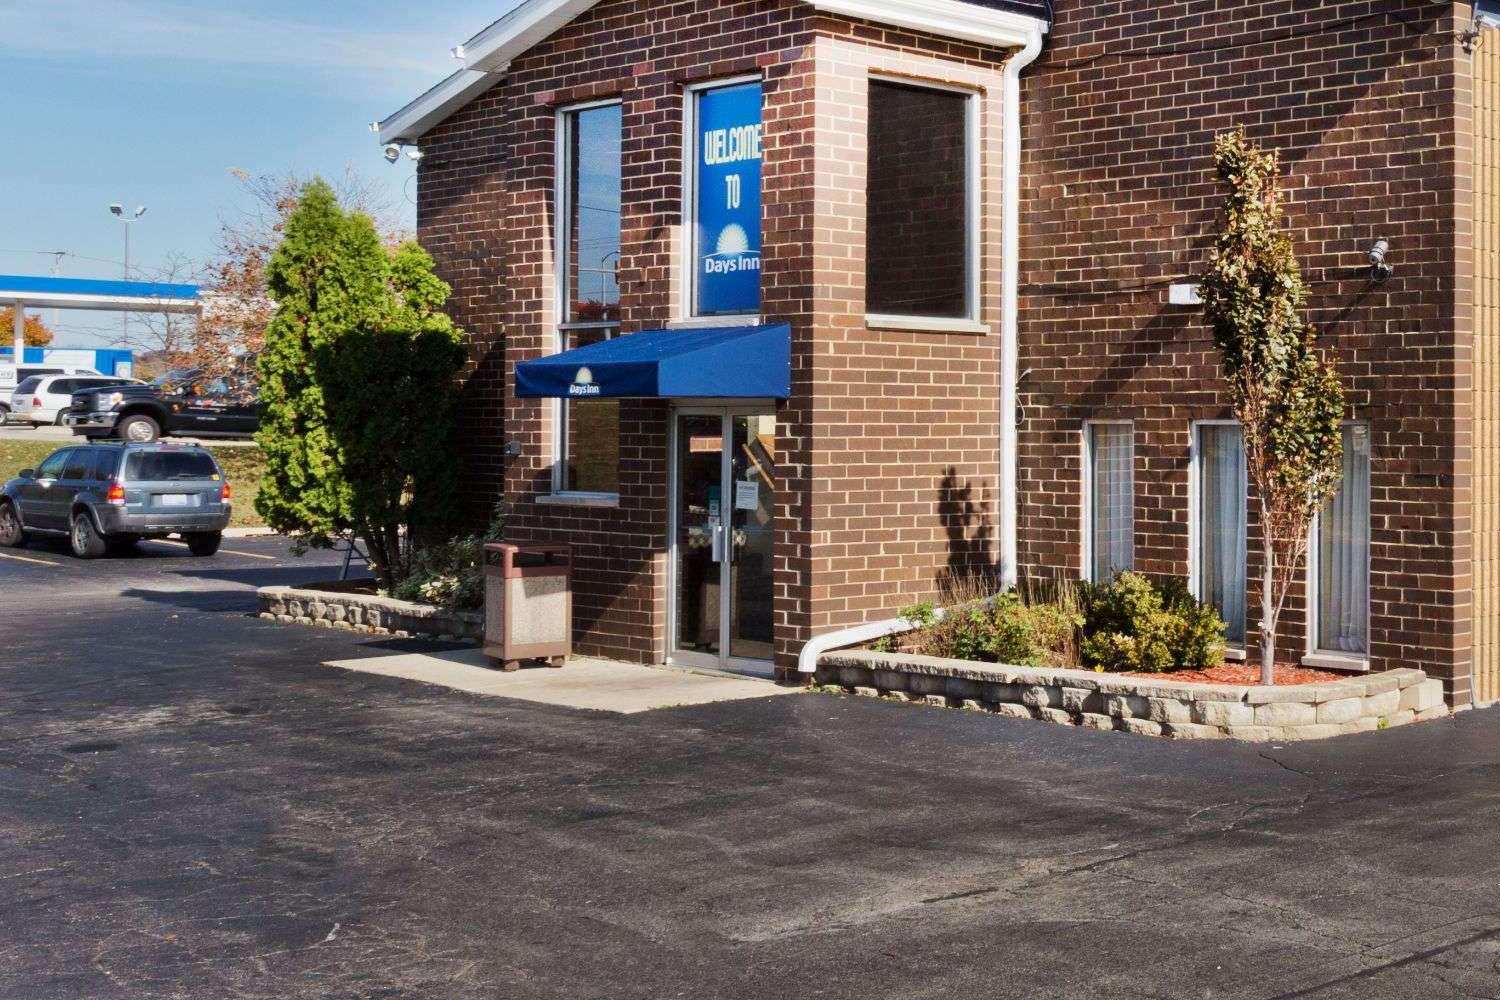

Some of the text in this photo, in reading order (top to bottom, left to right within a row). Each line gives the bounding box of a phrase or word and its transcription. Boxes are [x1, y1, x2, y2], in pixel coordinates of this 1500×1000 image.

[704, 123, 762, 165] WELCOME
[725, 174, 740, 209] TO
[705, 255, 760, 274] Days Inn
[570, 384, 600, 395] Days Inn
